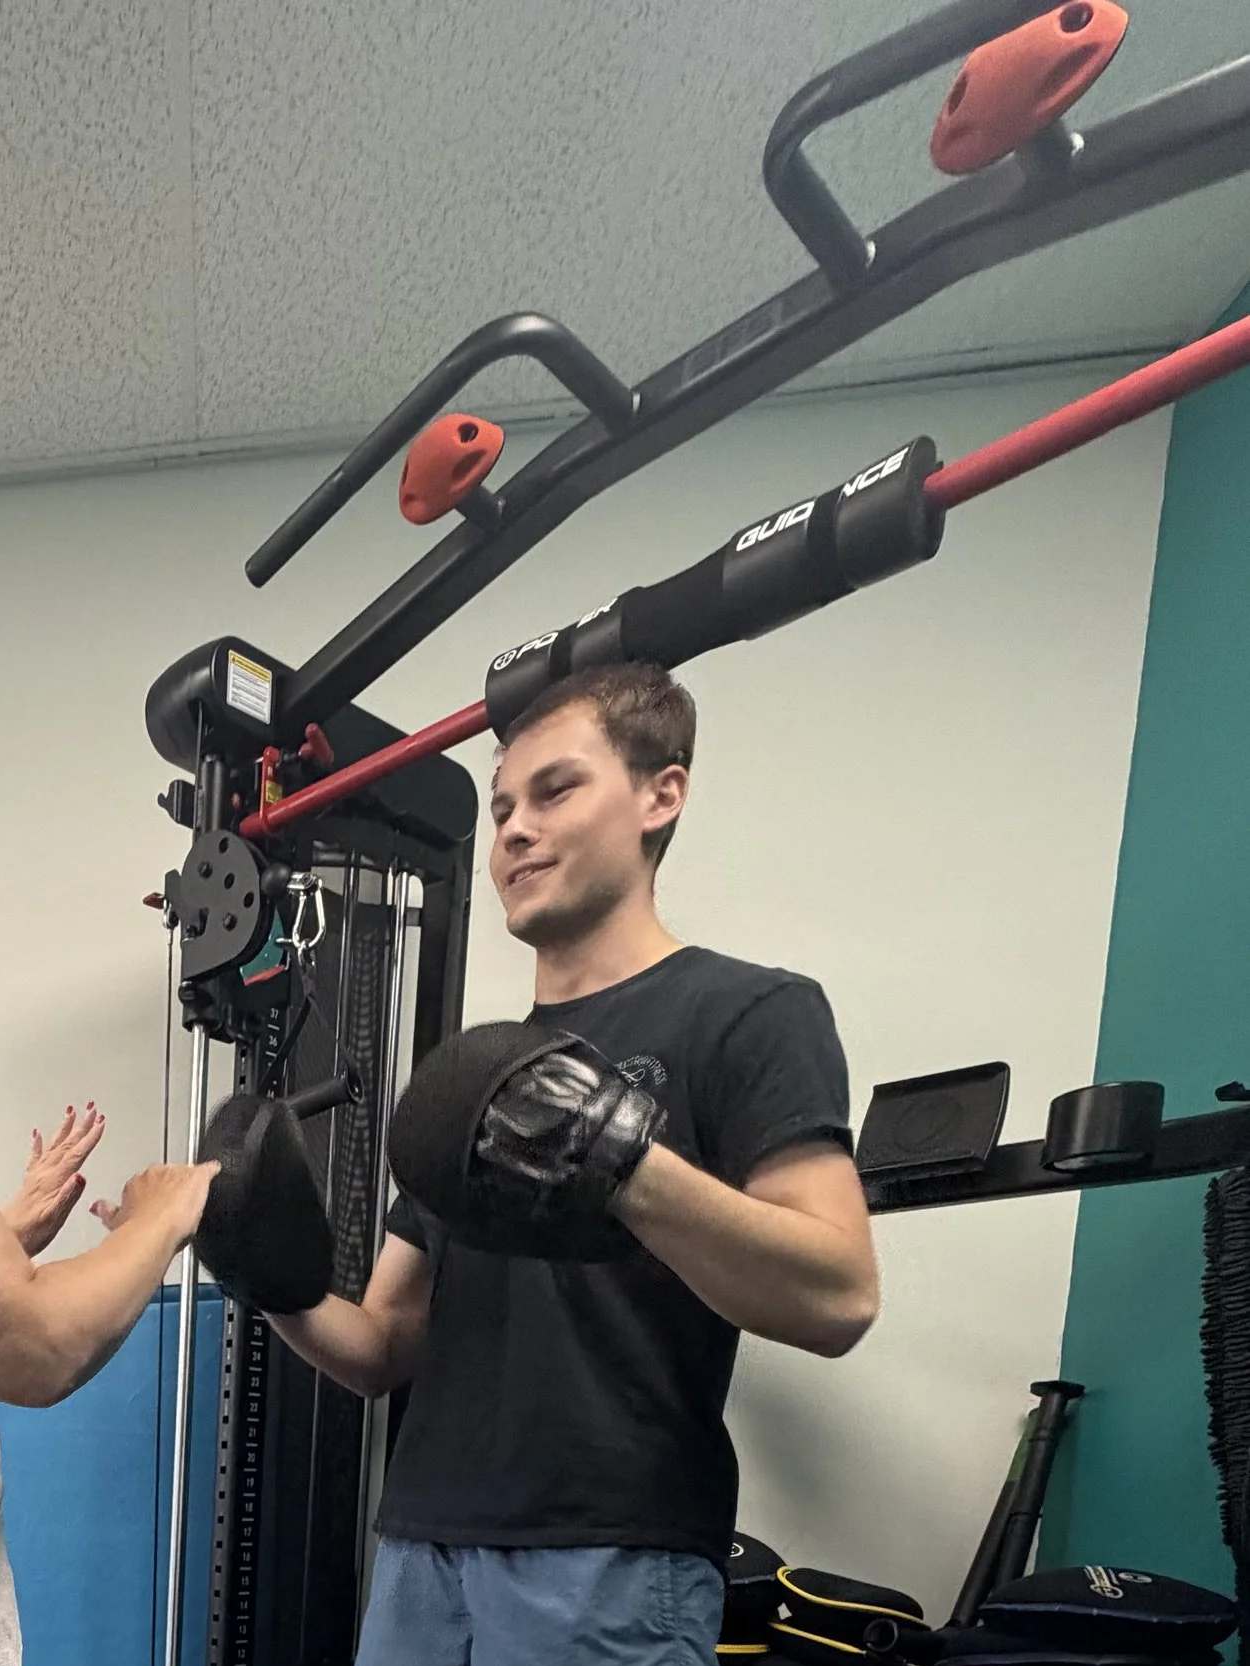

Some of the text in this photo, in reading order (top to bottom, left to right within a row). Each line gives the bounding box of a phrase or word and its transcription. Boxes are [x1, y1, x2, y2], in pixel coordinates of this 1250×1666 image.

[736, 447, 909, 552] GUIDNCE
[270, 1008, 279, 1019] 37
[268, 1034, 278, 1047] 36
[253, 1326, 262, 1336] 25
[252, 1351, 261, 1361] 24
[250, 1377, 259, 1387] 23
[249, 1402, 258, 1412] 22
[248, 1427, 256, 1437] 21
[246, 1452, 255, 1462] 20
[246, 1477, 254, 1487] 19
[245, 1502, 253, 1512] 18
[243, 1527, 252, 1537] 17
[242, 1552, 250, 1562] 16
[241, 1576, 249, 1586] 15
[240, 1600, 248, 1610] 14
[238, 1625, 247, 1634] 13
[237, 1649, 246, 1658] 12
